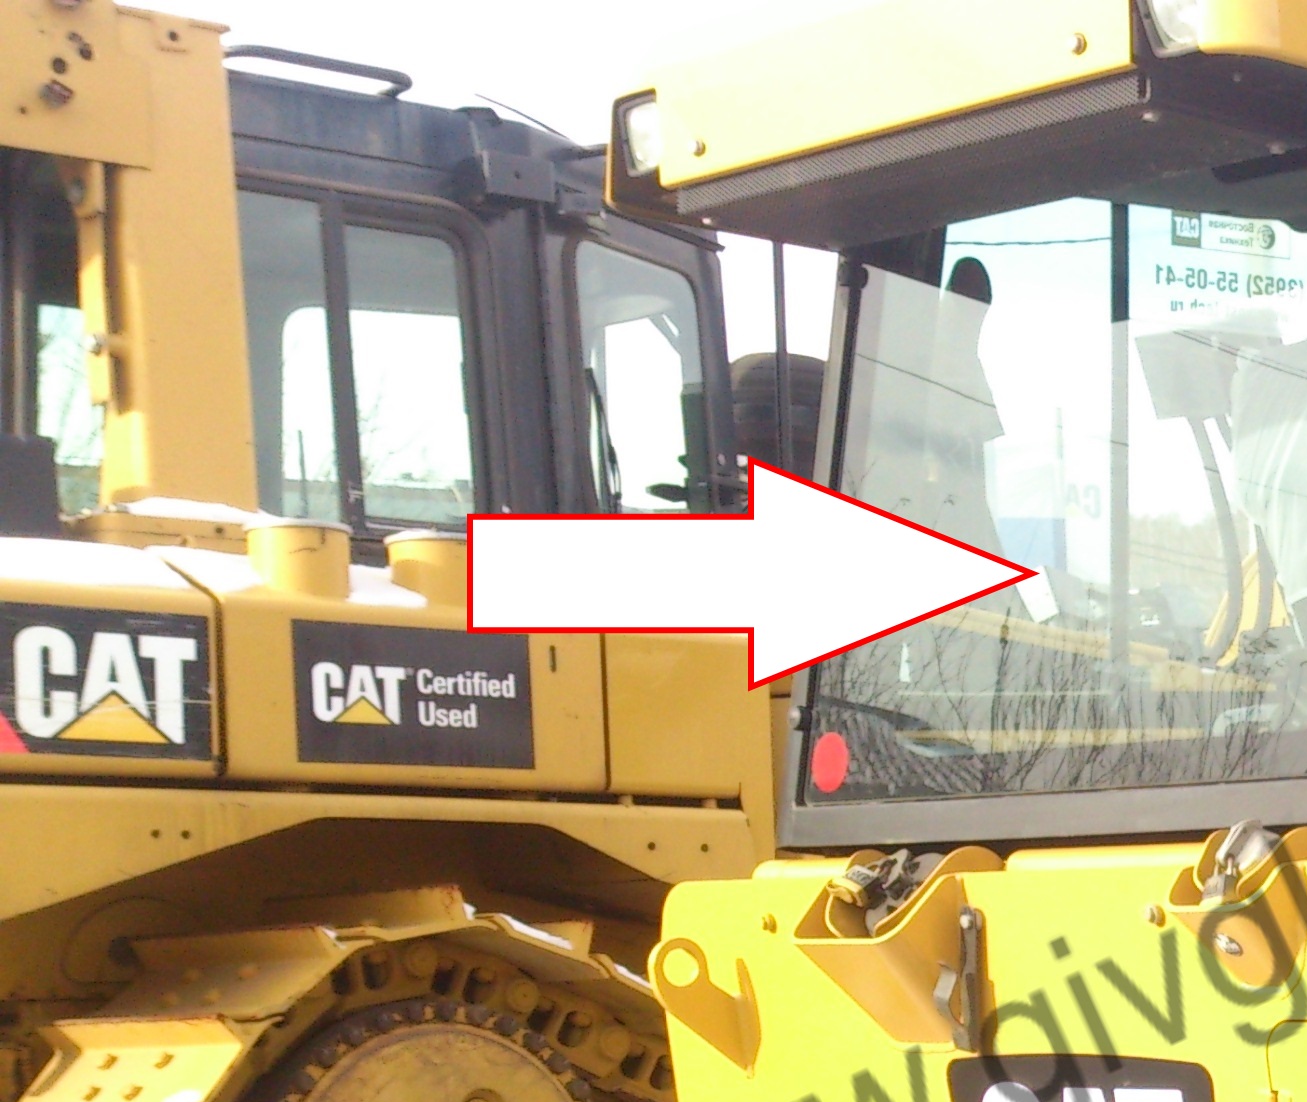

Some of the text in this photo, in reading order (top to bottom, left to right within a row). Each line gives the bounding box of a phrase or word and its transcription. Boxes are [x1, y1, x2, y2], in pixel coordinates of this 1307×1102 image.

[13, 625, 197, 745] CAT
[310, 661, 517, 725] CAT Certified
[418, 701, 479, 729] Used
